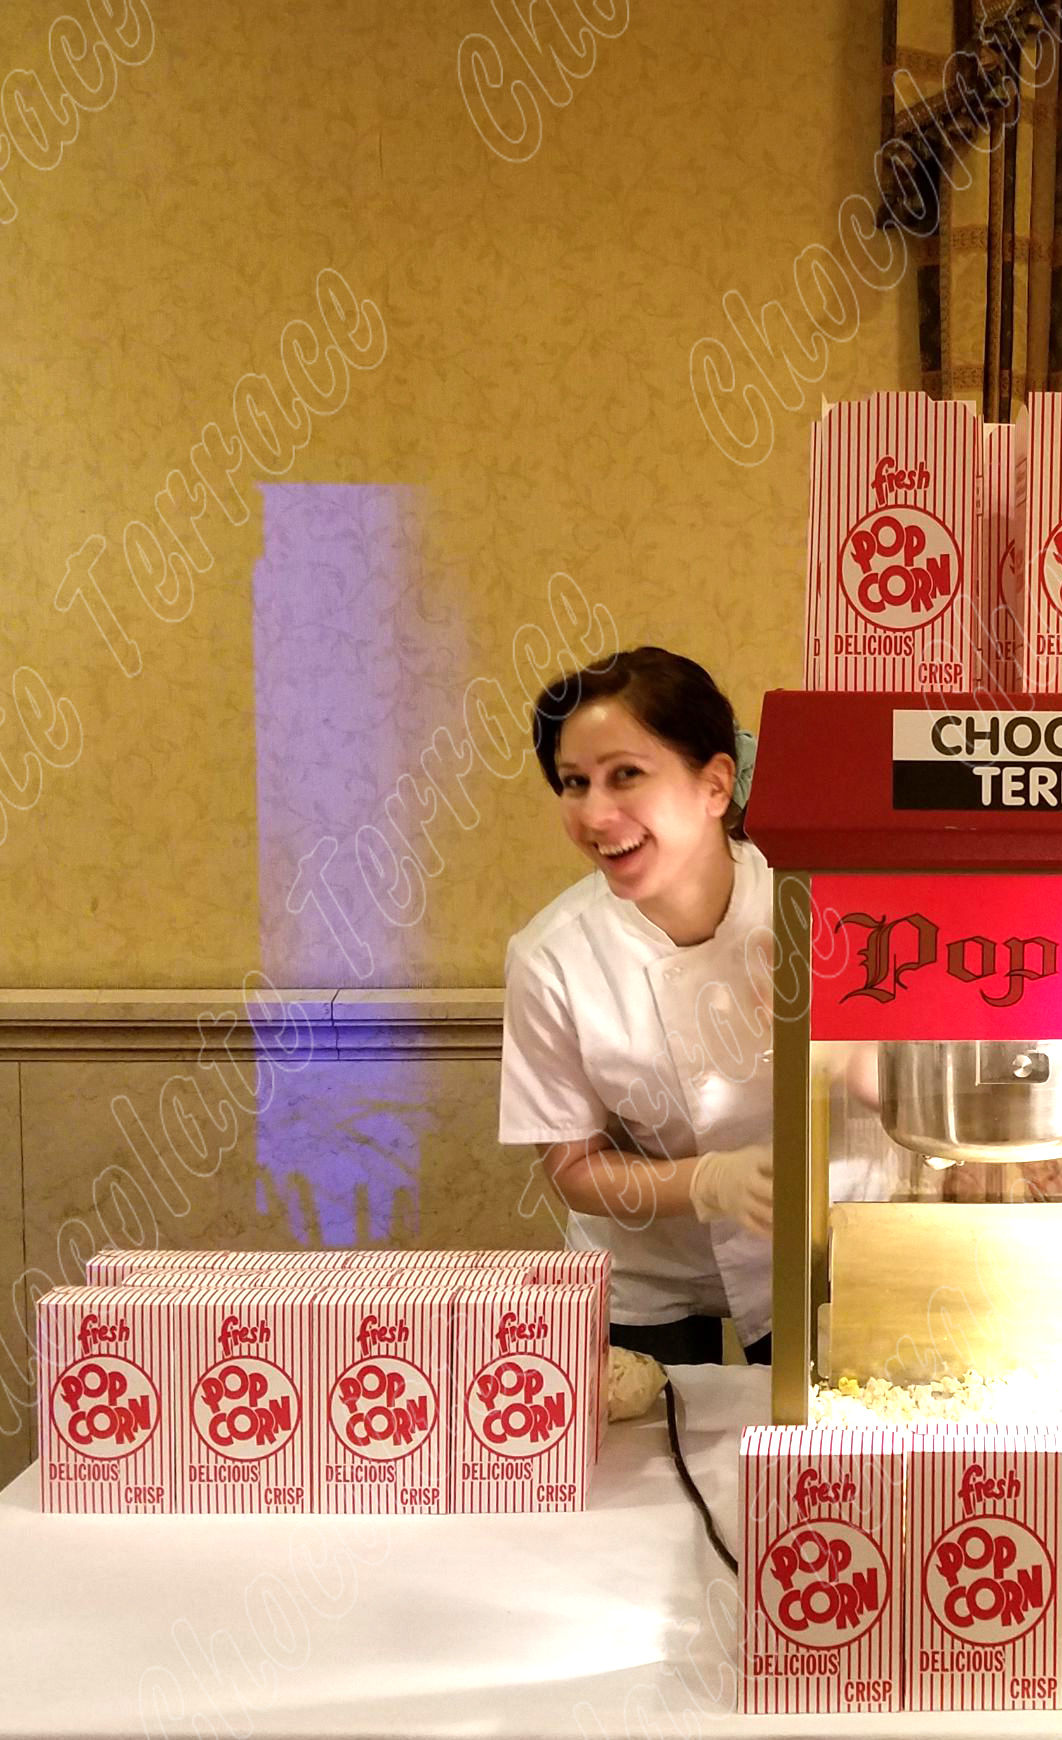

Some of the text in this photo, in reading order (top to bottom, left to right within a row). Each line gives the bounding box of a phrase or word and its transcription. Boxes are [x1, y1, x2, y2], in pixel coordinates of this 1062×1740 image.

[872, 456, 930, 505] fresh
[851, 516, 926, 573] POP
[858, 554, 950, 613] CORN
[834, 634, 914, 657] DELICIOUS
[918, 663, 963, 684] CRISP
[78, 1313, 130, 1354] fresh
[218, 1315, 270, 1356] fresh
[357, 1315, 409, 1356] fresh
[496, 1312, 548, 1353] fresh
[61, 1364, 127, 1411] POP
[201, 1365, 268, 1413] POP
[339, 1365, 405, 1413] POP
[476, 1362, 544, 1410] POP
[68, 1395, 150, 1445] CORN
[209, 1396, 291, 1446] CORN
[346, 1396, 427, 1446] CORN
[483, 1392, 565, 1443] CORN
[49, 1463, 119, 1481] DELICIOUS
[189, 1465, 259, 1482] DELICIOUS
[325, 1465, 395, 1483] DELICIOUS
[462, 1462, 532, 1480] DELICIOUS
[958, 1464, 1021, 1516] fresh
[124, 1487, 164, 1504] CRISP
[264, 1487, 304, 1505] CRISP
[400, 1488, 439, 1505] CRISP
[537, 1484, 576, 1502] CRISP
[794, 1468, 856, 1519] fresh
[770, 1530, 851, 1591] POP
[936, 1526, 1016, 1587] POP
[779, 1568, 878, 1630] CORN
[944, 1565, 1043, 1627] CORN
[754, 1654, 839, 1676] DELICIOUS
[920, 1651, 1005, 1673] DELICIOUS
[845, 1680, 892, 1702] CRISP
[1010, 1678, 1057, 1699] CRISP
